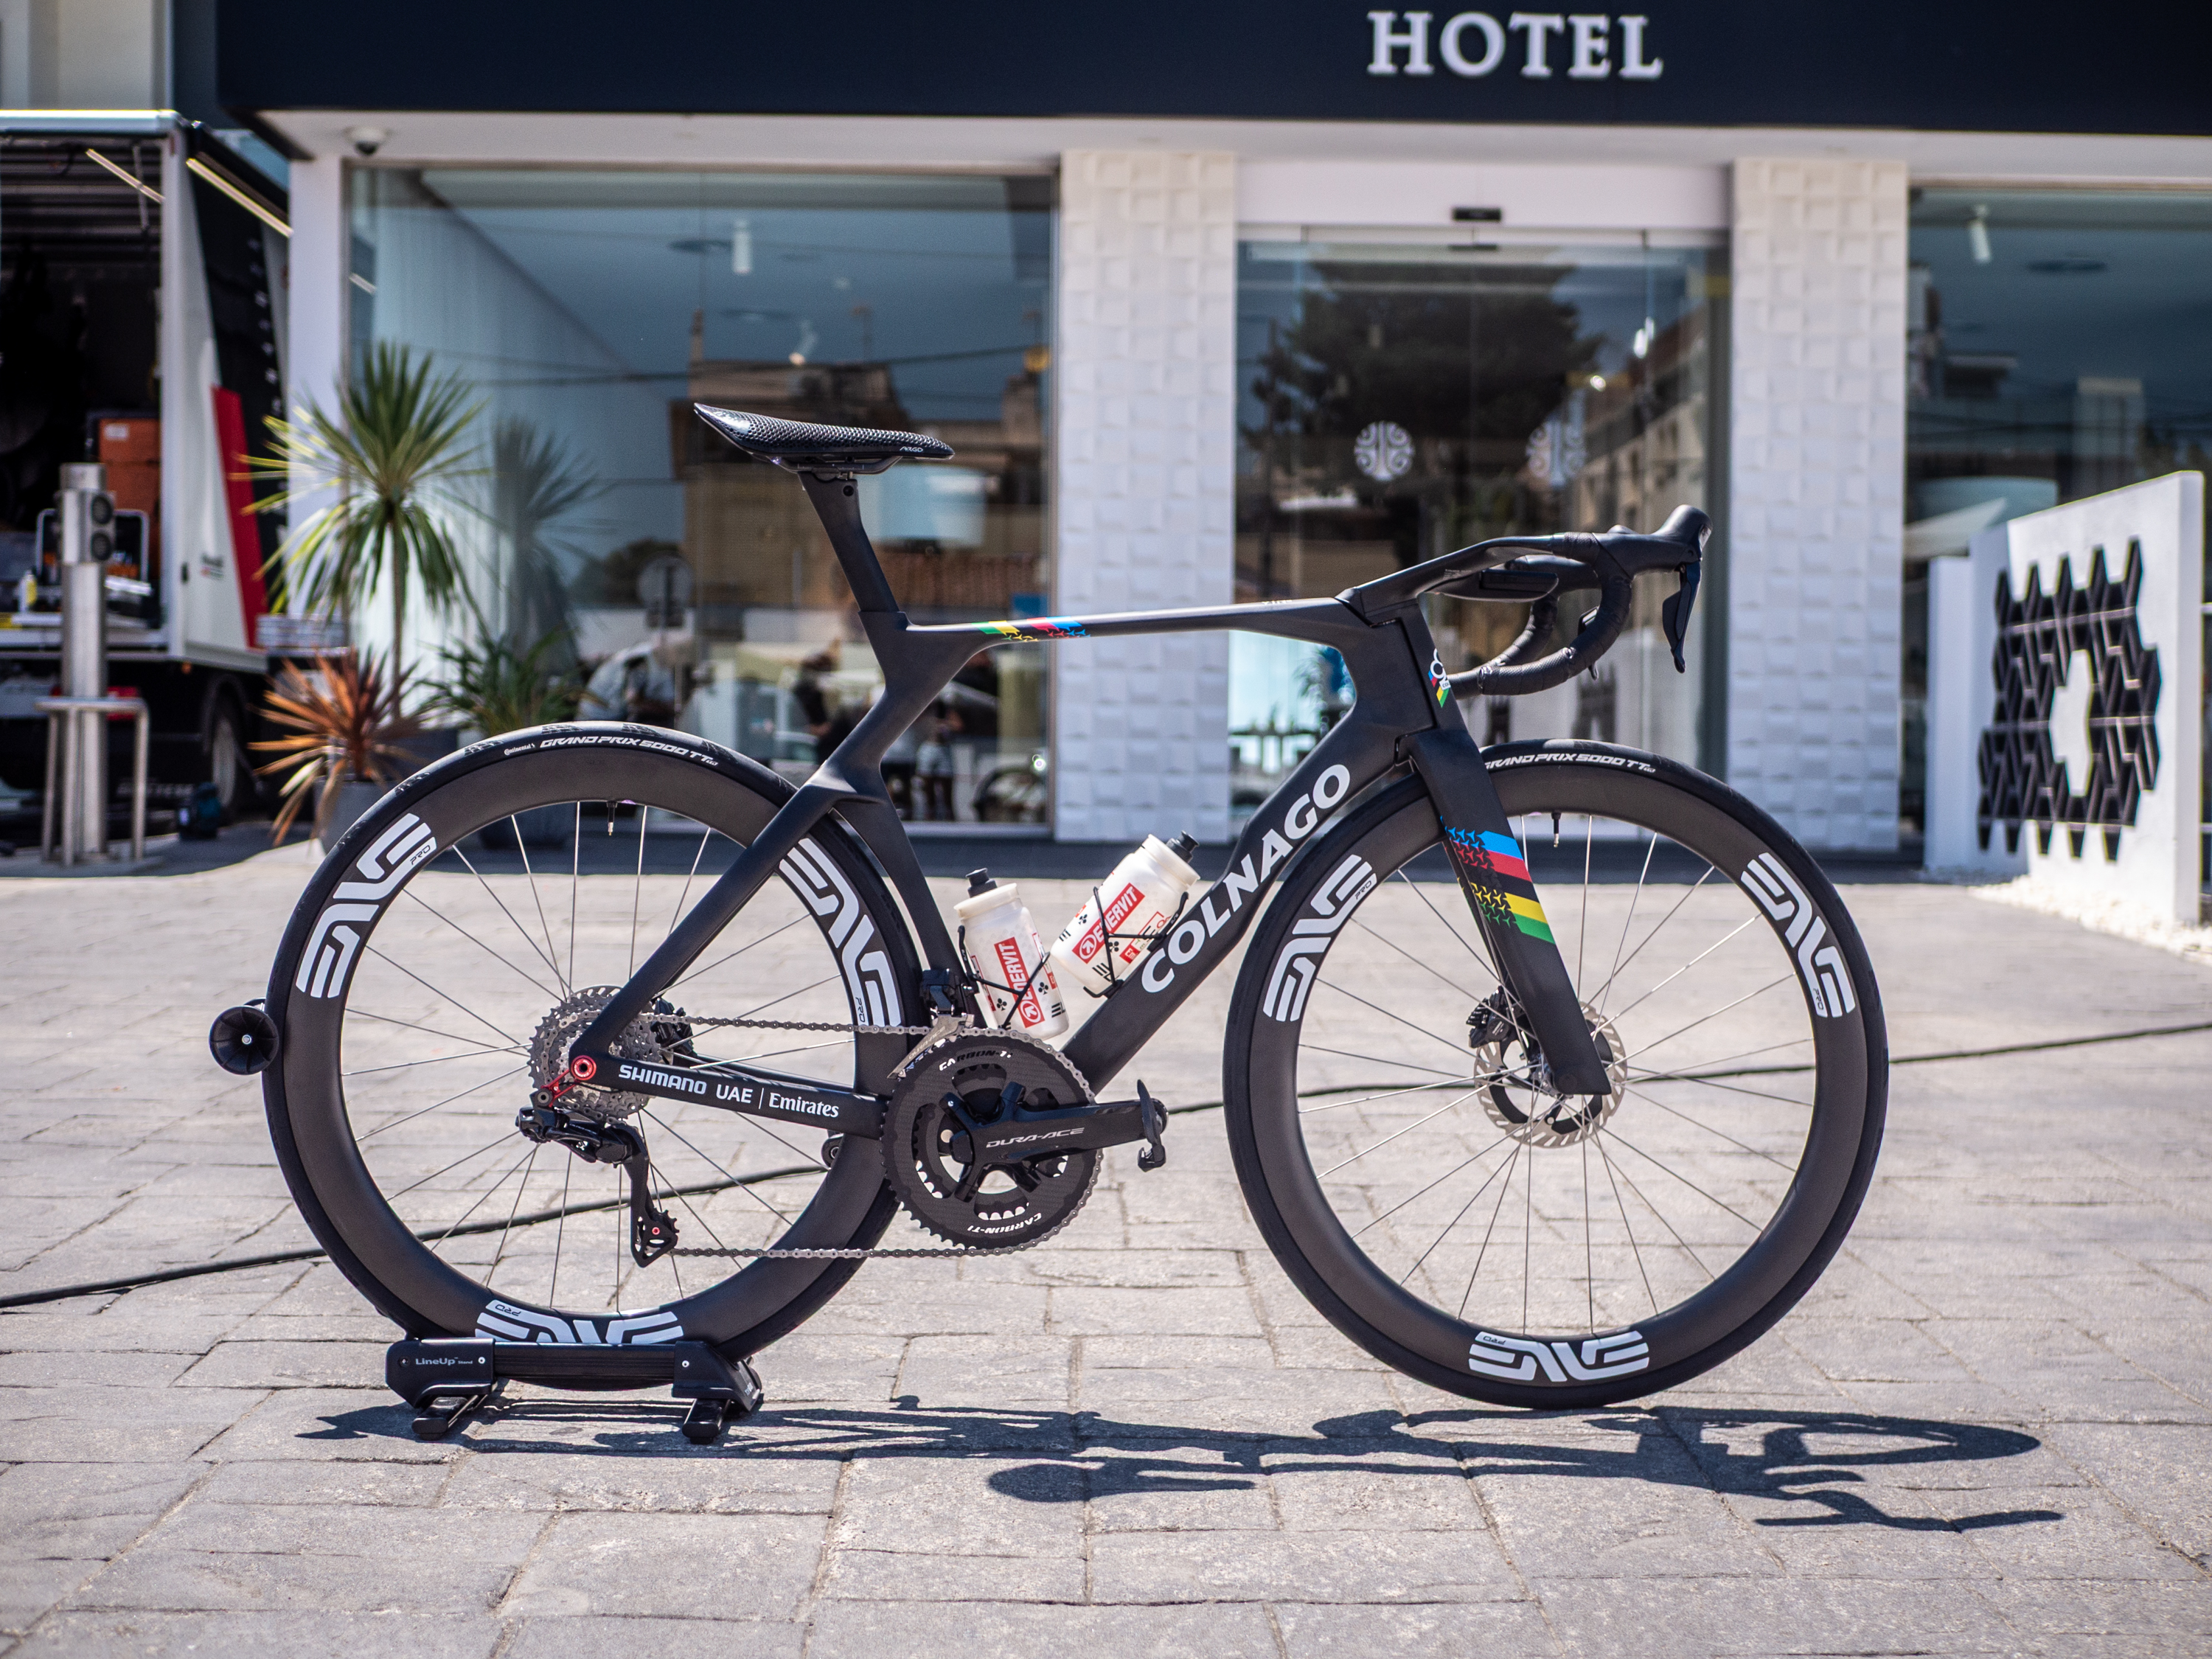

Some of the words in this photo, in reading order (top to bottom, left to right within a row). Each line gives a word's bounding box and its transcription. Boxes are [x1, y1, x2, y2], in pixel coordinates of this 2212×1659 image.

[1367, 10, 1664, 79] HOTEL
[540, 736, 599, 748] GRAND
[598, 736, 641, 745] PRIX
[639, 740, 689, 755] 5000
[689, 751, 713, 762] TT
[1534, 753, 1578, 762] PRIX
[1578, 754, 1626, 766] 5000
[411, 845, 431, 866] PRO
[1141, 764, 1351, 992] COLNAGO
[1354, 880, 1372, 900] PRO
[1814, 988, 1824, 1010] PRO
[855, 997, 866, 1023] PRO
[619, 1064, 707, 1095] SHIMANO
[716, 1084, 753, 1104] UAE
[768, 1093, 839, 1118] Emirates
[986, 1127, 1085, 1148] DURA-ACE
[495, 1304, 521, 1317] PRO
[1482, 1335, 1506, 1346] PRO
